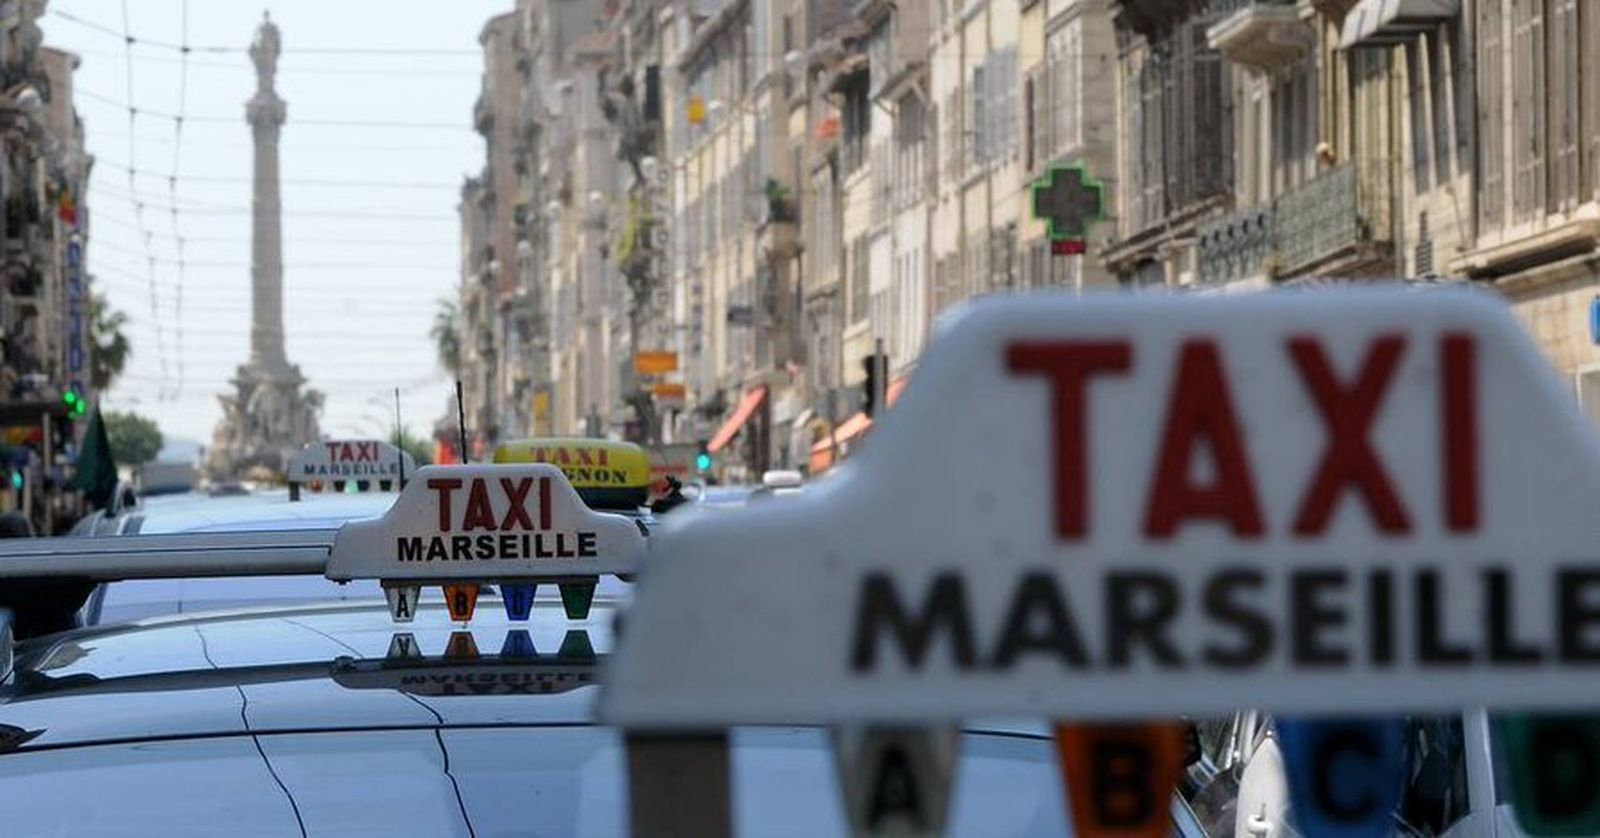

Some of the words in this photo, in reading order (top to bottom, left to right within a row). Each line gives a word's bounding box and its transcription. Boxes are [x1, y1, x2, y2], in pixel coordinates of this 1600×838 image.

[304, 463, 398, 475] MARSEILLE
[325, 440, 379, 462] TAXI
[531, 446, 608, 466] TAXI
[1005, 331, 1480, 541] TAXI
[427, 477, 553, 532] TAXI
[397, 532, 598, 562] MARSEILLE
[397, 592, 410, 618] A
[851, 566, 1600, 674] MARSEILLE
[867, 736, 926, 833] A
[1088, 733, 1157, 829] B
[1313, 727, 1388, 822] C
[1527, 730, 1600, 832] D
